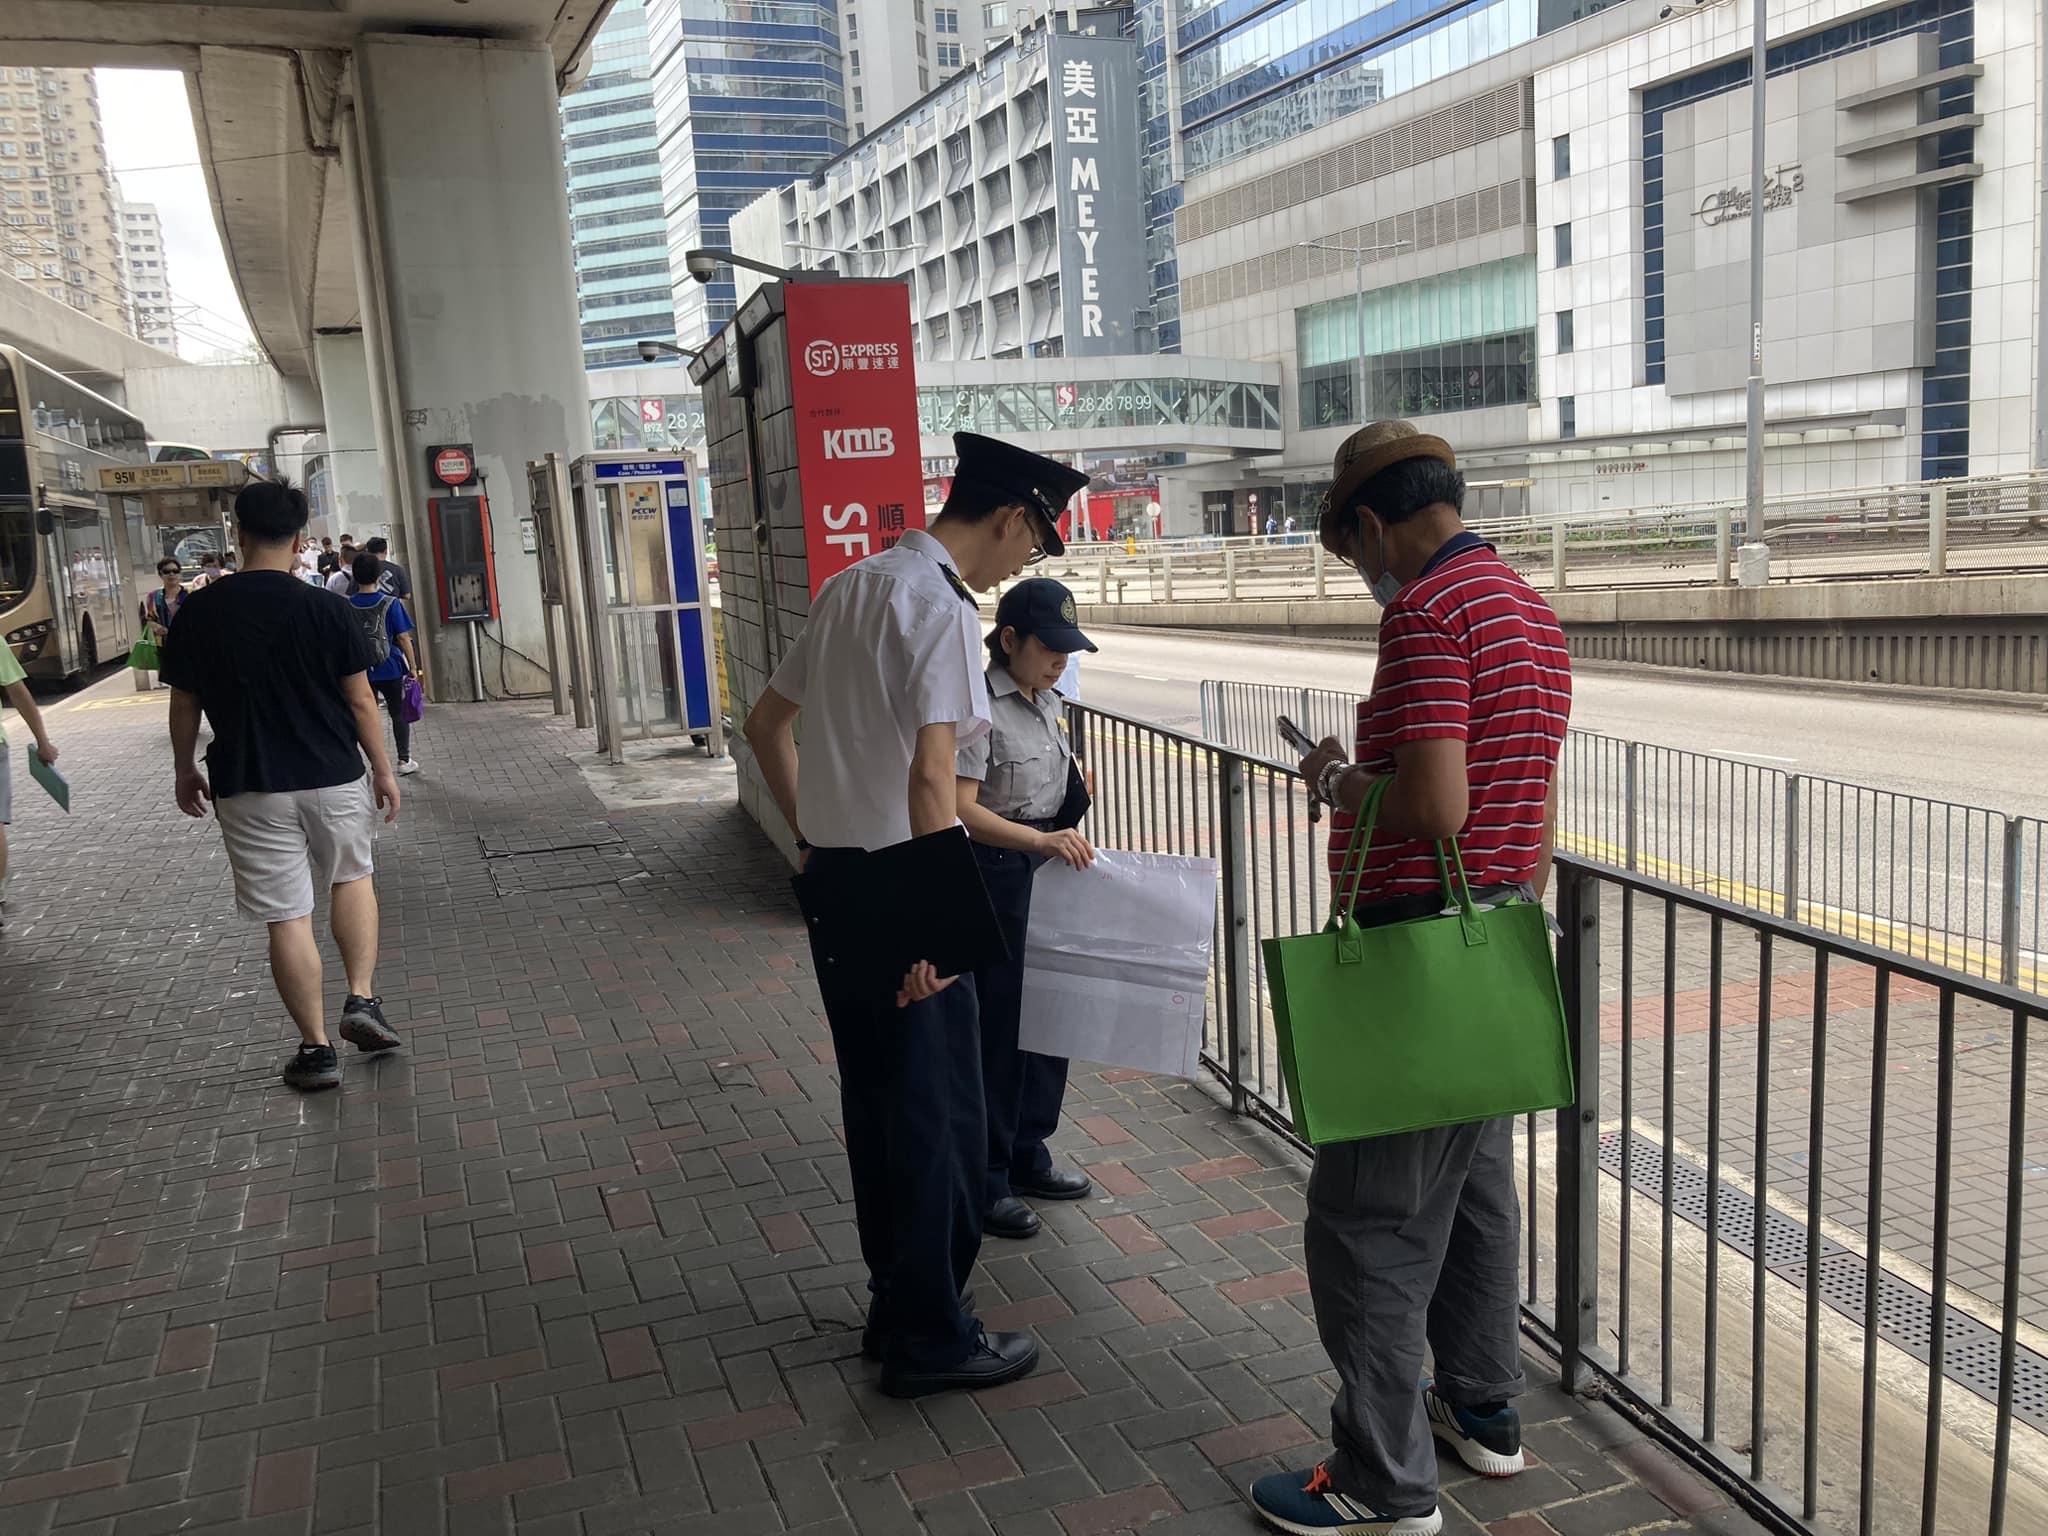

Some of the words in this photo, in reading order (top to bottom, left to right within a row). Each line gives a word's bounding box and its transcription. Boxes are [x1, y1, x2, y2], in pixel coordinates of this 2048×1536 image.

[1062, 59, 1100, 144] 美亞
[1070, 157, 1104, 338] MEYER
[811, 350, 833, 368] SF
[841, 343, 899, 357] EXPRESS
[1078, 397, 1095, 412] 28
[1097, 396, 1114, 411] 28
[1117, 395, 1133, 410] 78
[1135, 394, 1152, 410] 99
[667, 412, 688, 429] 28
[691, 412, 705, 429] 2
[114, 471, 136, 484] 95M
[631, 507, 657, 515] PCCW
[823, 502, 870, 557] SF
